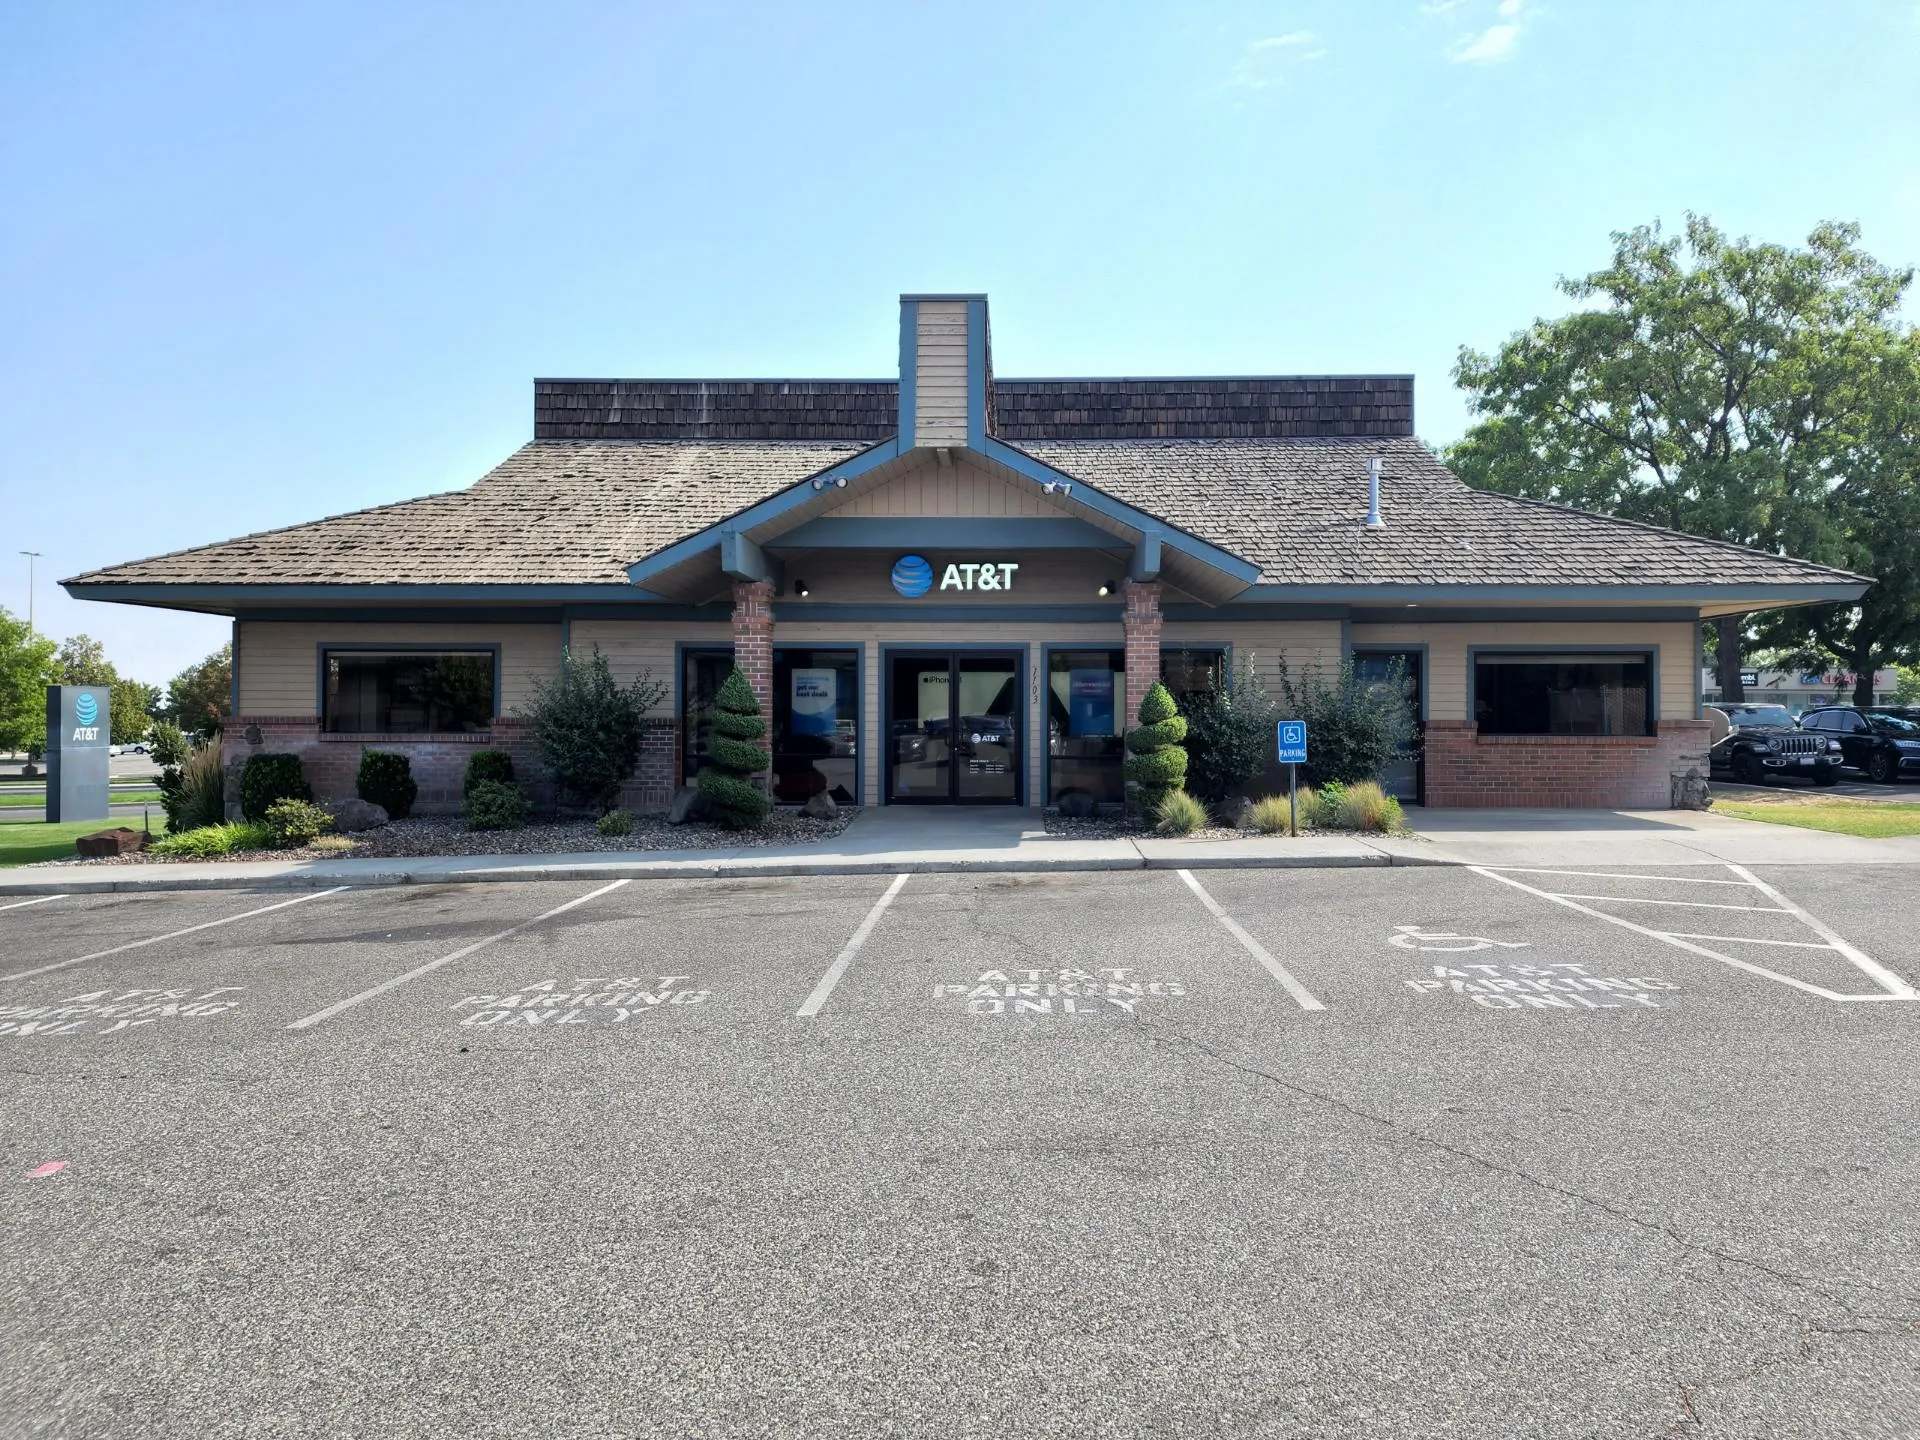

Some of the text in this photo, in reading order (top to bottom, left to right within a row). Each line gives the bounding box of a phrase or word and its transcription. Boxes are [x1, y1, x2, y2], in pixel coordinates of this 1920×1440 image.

[939, 563, 1019, 591] AT&T
[73, 727, 100, 742] AT&T
[1279, 748, 1306, 758] PARKING
[976, 968, 1132, 982] AT&T
[1433, 964, 1590, 977] AT&T
[518, 976, 690, 992] AT&T
[932, 982, 1186, 998] PARKING
[1403, 977, 1681, 993] PARKING
[58, 986, 246, 1003] AT&T
[448, 990, 711, 1010] PARKING
[1469, 993, 1664, 1009] ONLY
[967, 998, 1142, 1014] ONLY
[459, 1007, 653, 1026] ONLY
